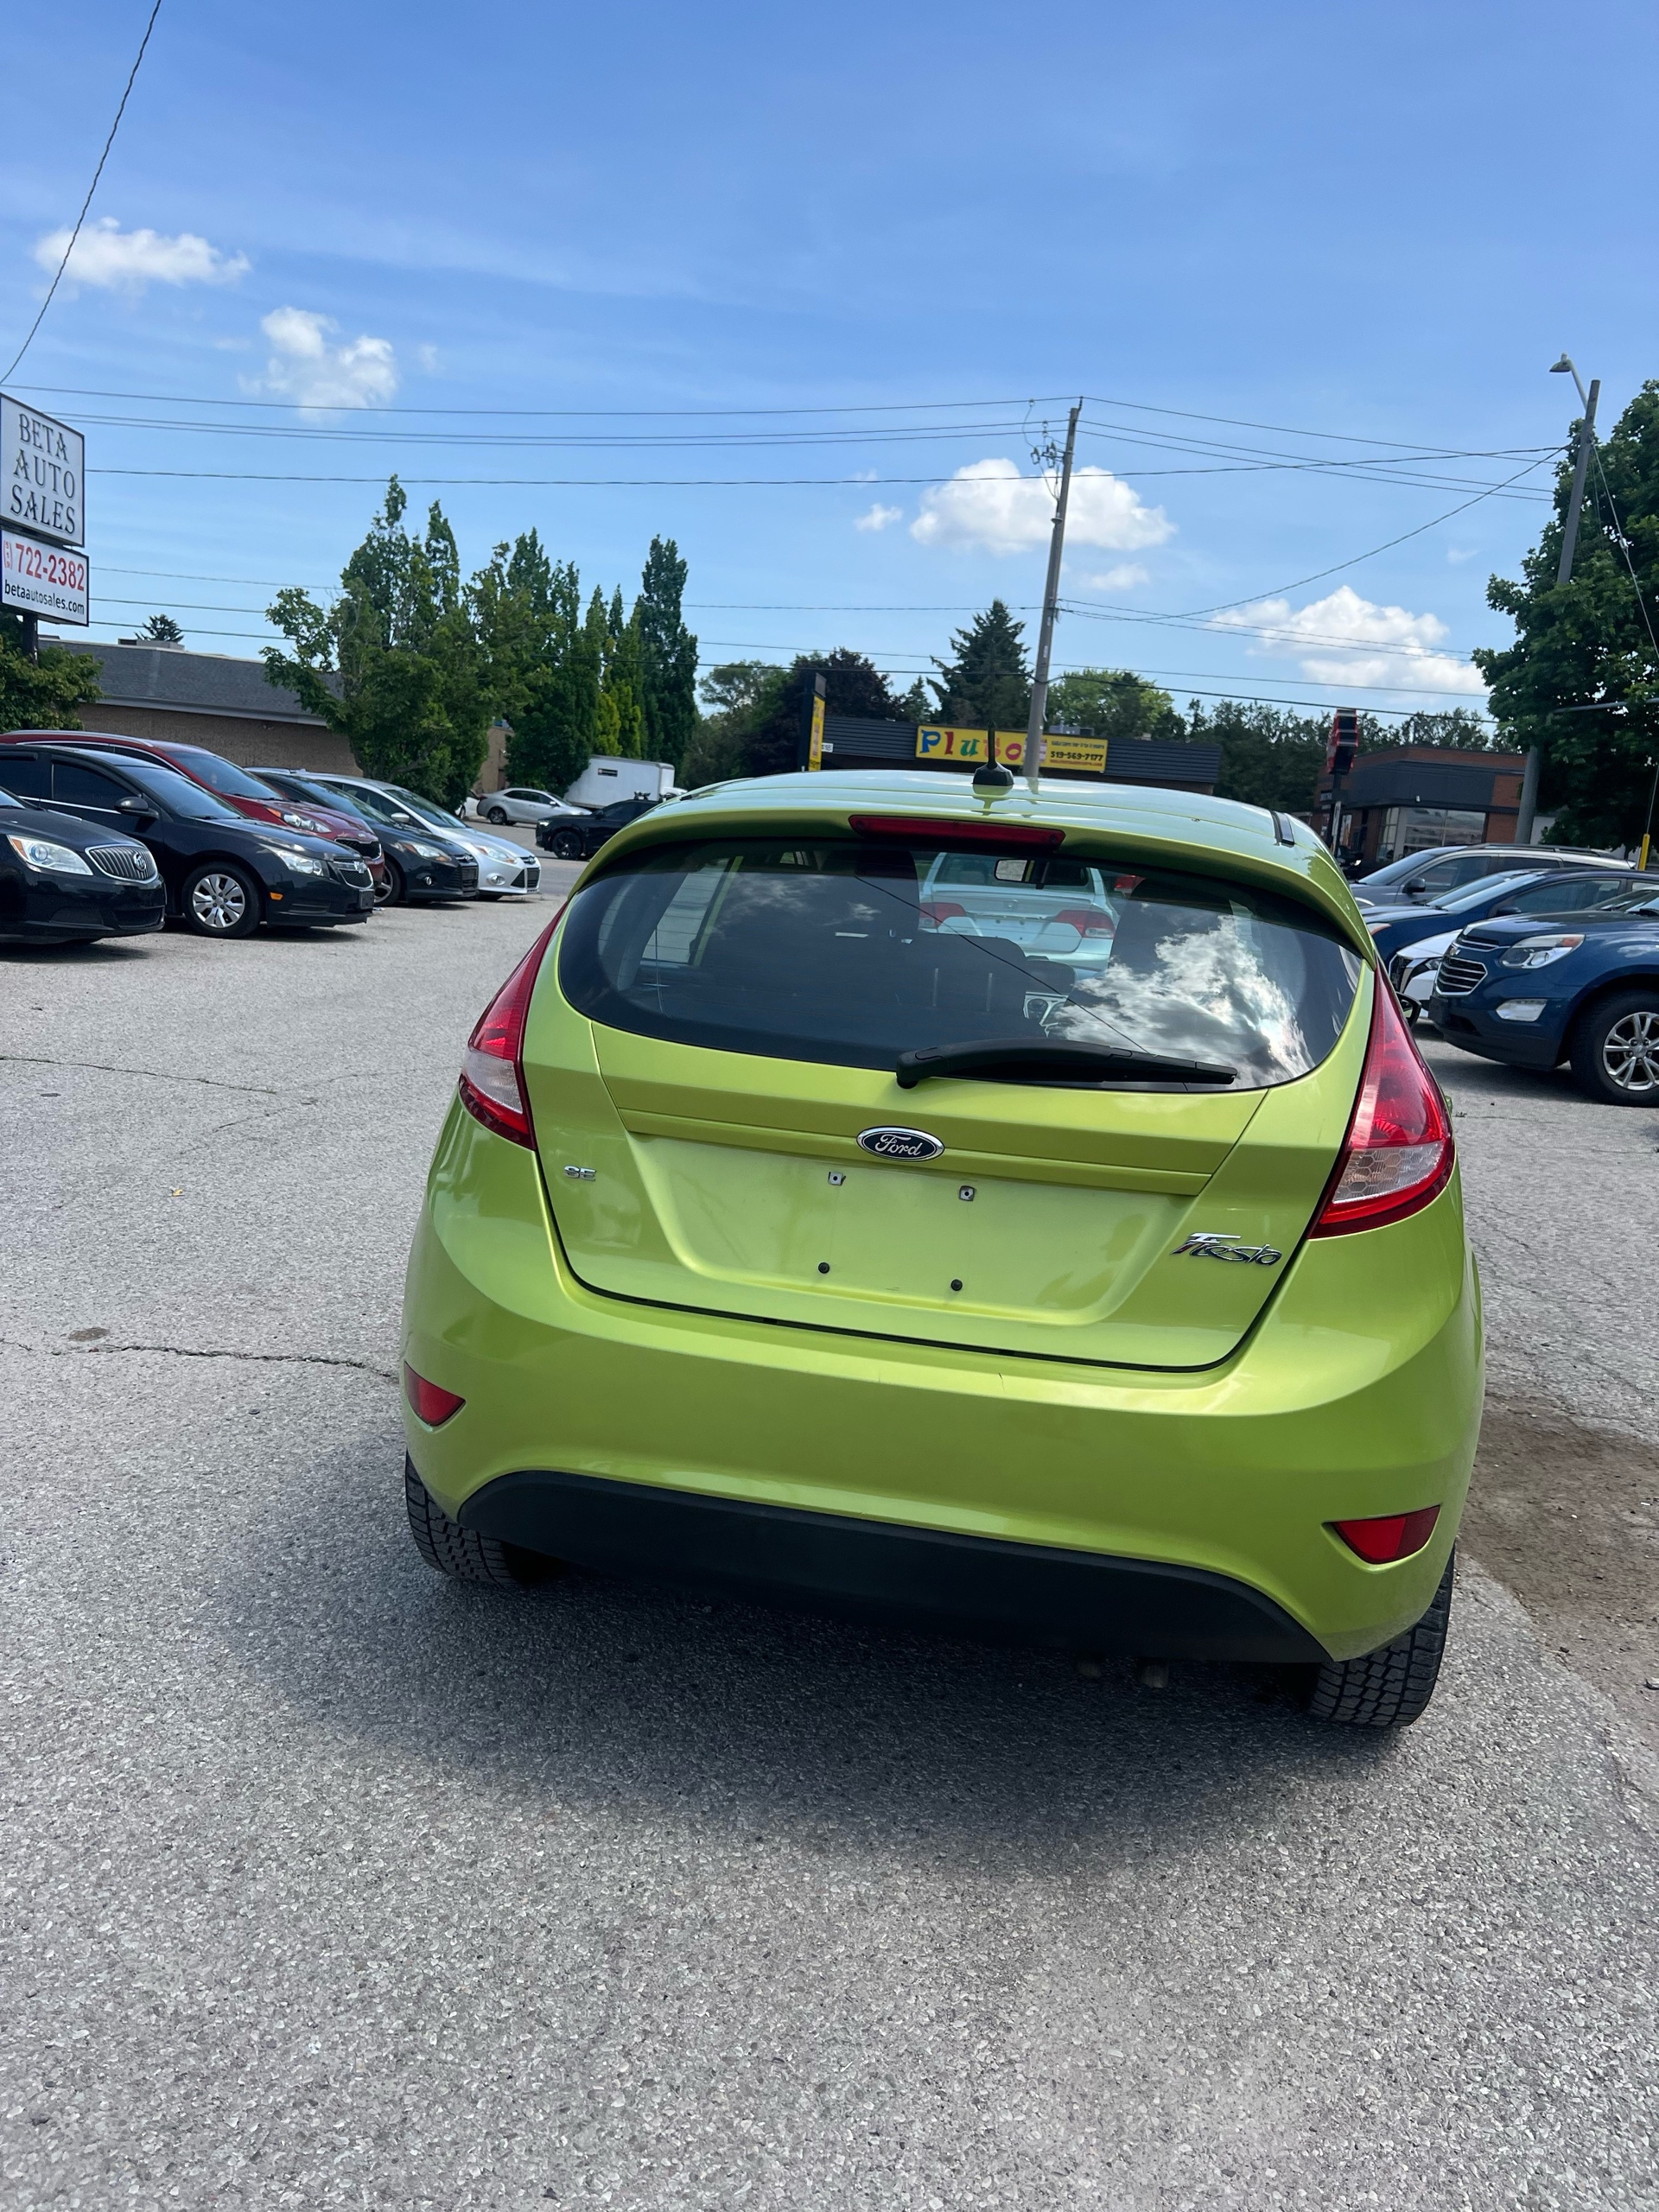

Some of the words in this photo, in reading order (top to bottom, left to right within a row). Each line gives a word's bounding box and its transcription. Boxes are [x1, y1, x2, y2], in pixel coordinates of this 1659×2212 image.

[18, 413, 69, 461] BETA
[13, 448, 75, 499] AUTO
[10, 484, 75, 534] SALES
[16, 543, 85, 591] 722-2382
[4, 579, 85, 614] betaautosales.com
[1050, 751, 1103, 761] 519-569-7177
[874, 1134, 924, 1156] Ford
[564, 1166, 596, 1181] SE
[1170, 1232, 1282, 1265] Fiesta
